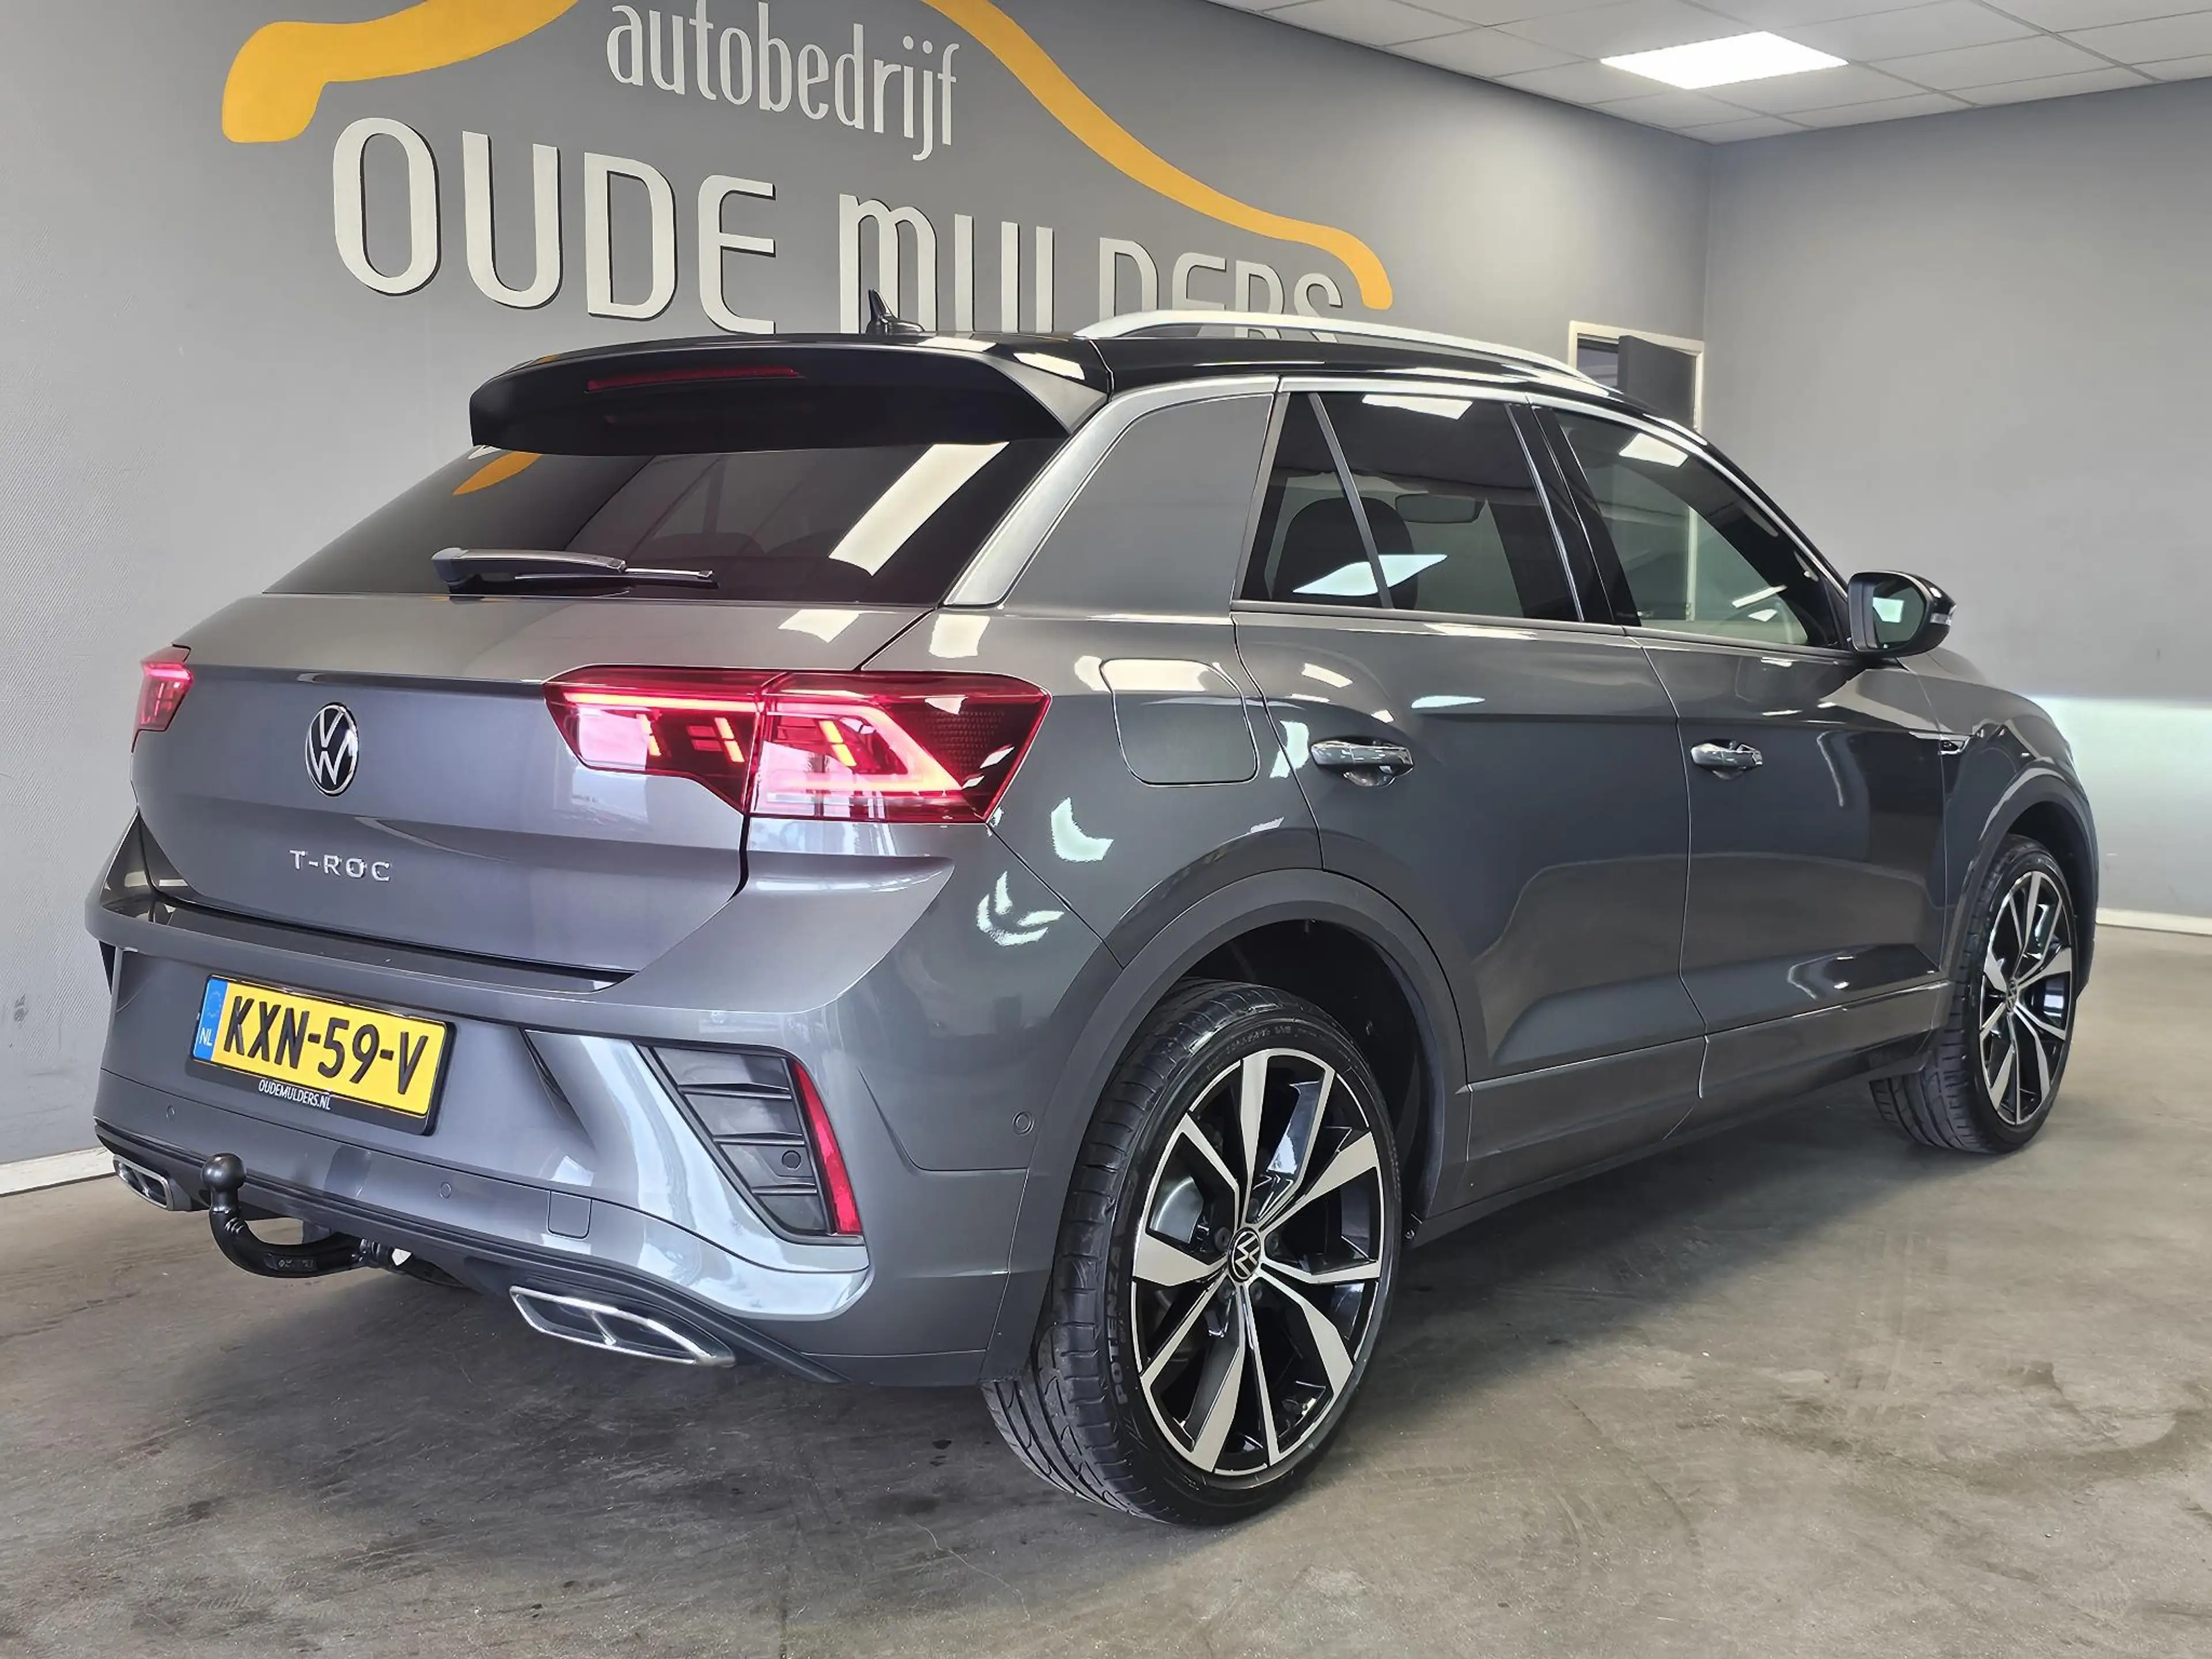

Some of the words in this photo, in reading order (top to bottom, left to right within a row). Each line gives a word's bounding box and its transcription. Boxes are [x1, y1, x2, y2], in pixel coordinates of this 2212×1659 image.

[606, 0, 960, 161] autobedrijf
[332, 117, 776, 334] OUDE
[289, 850, 392, 881] T-ROC
[199, 1027, 213, 1047] NL
[224, 995, 429, 1094] KXN-59-V
[259, 1079, 331, 1110] OUDEMULDERS.NL
[1108, 1247, 1128, 1404] POTENZA
